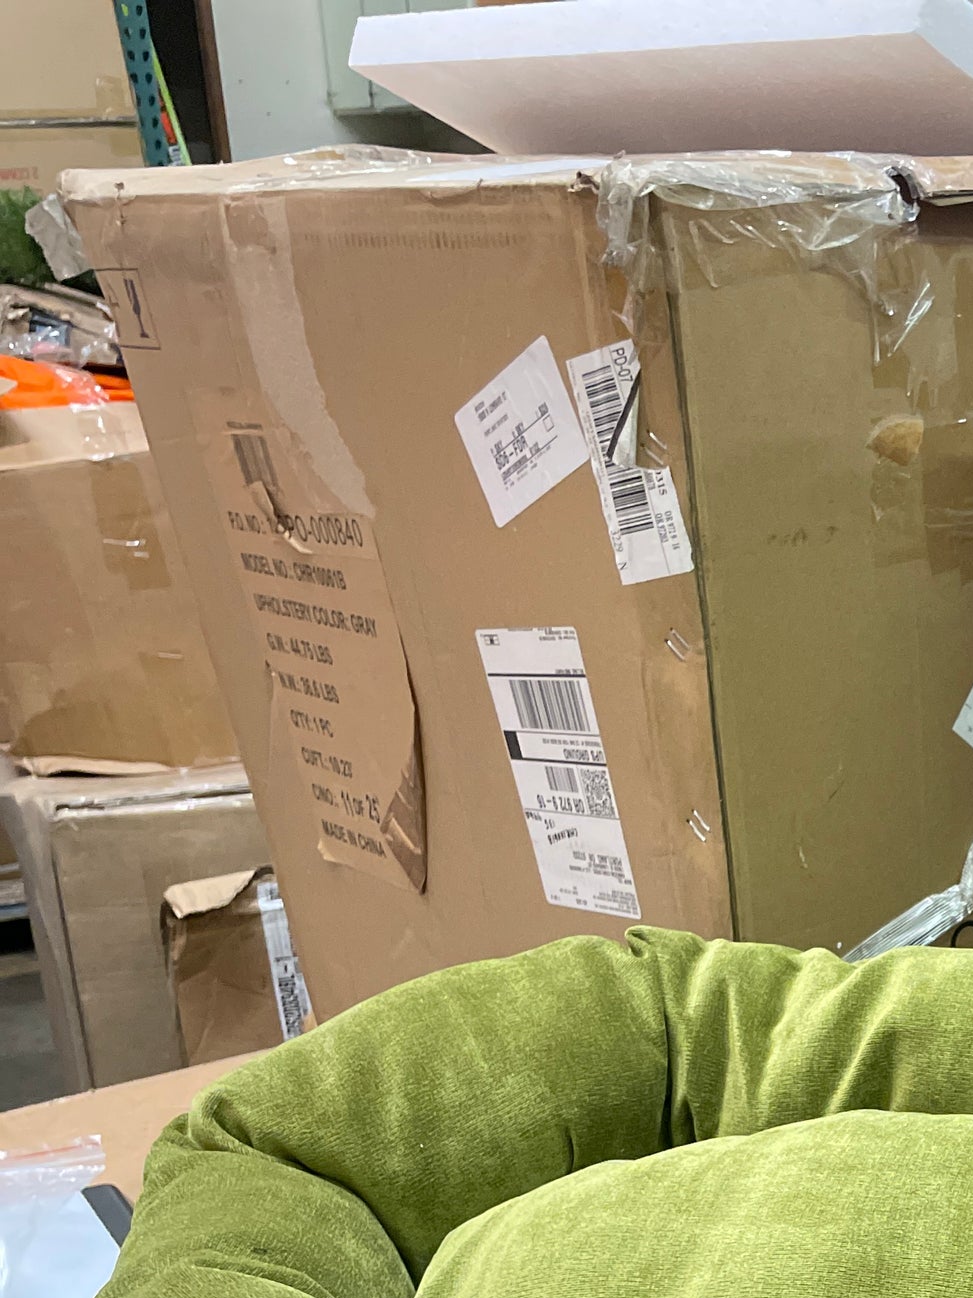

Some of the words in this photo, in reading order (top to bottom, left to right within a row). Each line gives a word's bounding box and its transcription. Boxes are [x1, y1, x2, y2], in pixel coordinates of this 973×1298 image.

[613, 347, 633, 384] PD-07
[240, 552, 275, 577] MODEL
[252, 592, 313, 624] UPHOLSTERY
[312, 605, 350, 632] COLOR:
[350, 613, 377, 639] GRAY
[313, 643, 334, 667] LBS
[319, 682, 340, 705] LBS
[319, 717, 334, 739] PC
[562, 748, 590, 762] GROUND
[340, 789, 355, 818] 11
[353, 797, 366, 817] OF
[321, 818, 349, 844] MADE
[346, 828, 358, 848] IN
[356, 833, 387, 859] CHINA
